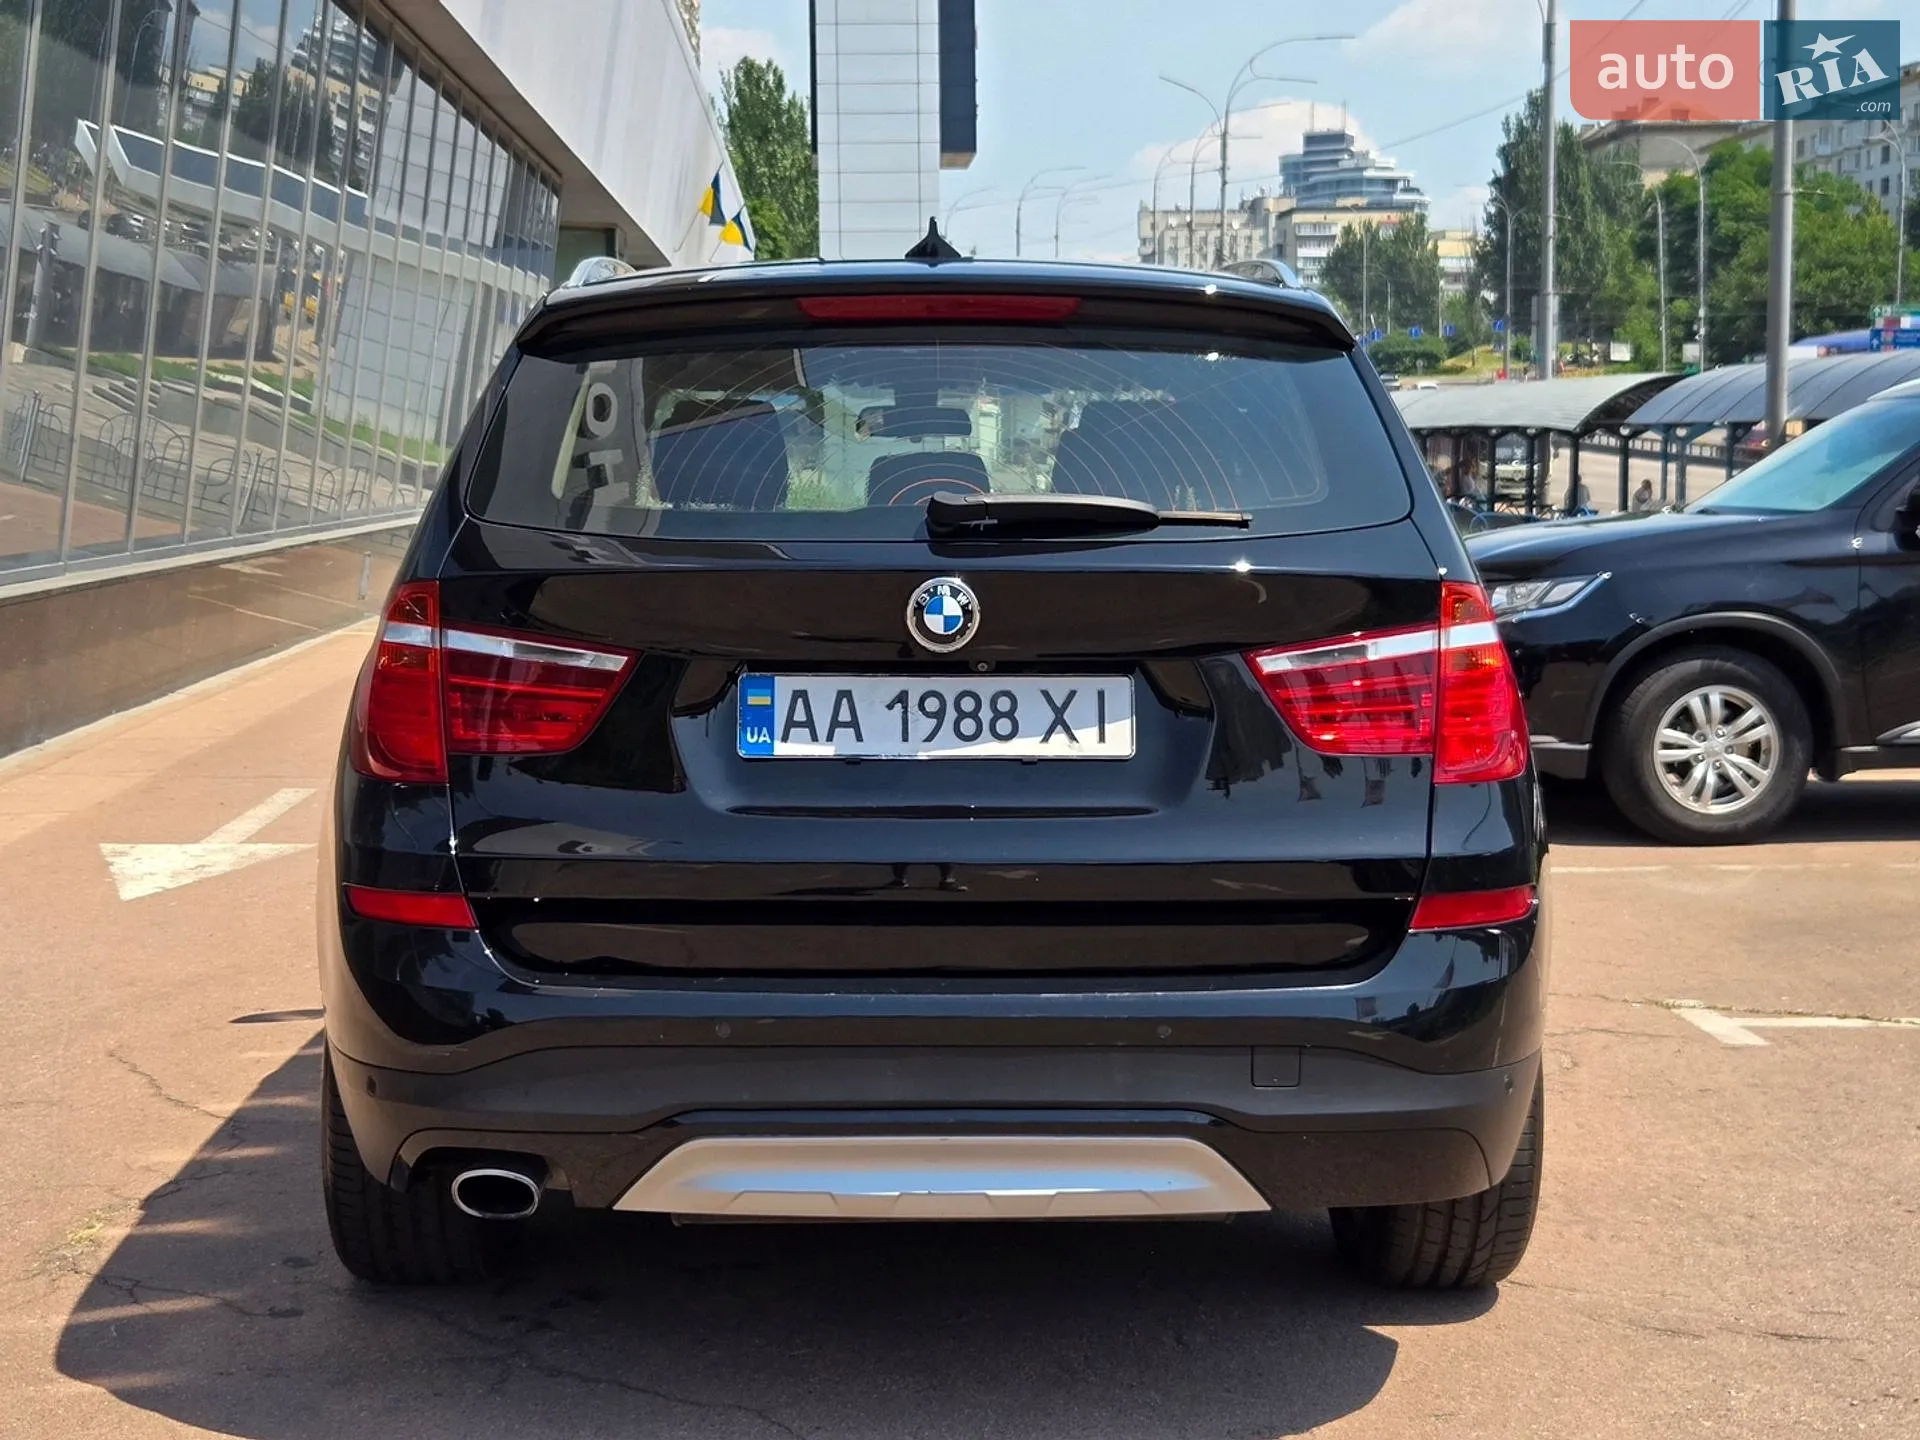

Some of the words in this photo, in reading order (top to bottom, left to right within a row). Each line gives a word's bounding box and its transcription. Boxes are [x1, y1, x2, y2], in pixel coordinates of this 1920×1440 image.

[917, 585, 969, 606] BMW
[781, 689, 864, 743] AA
[885, 689, 1020, 743] 1988
[1039, 689, 1106, 744] XI
[746, 727, 772, 744] UA
